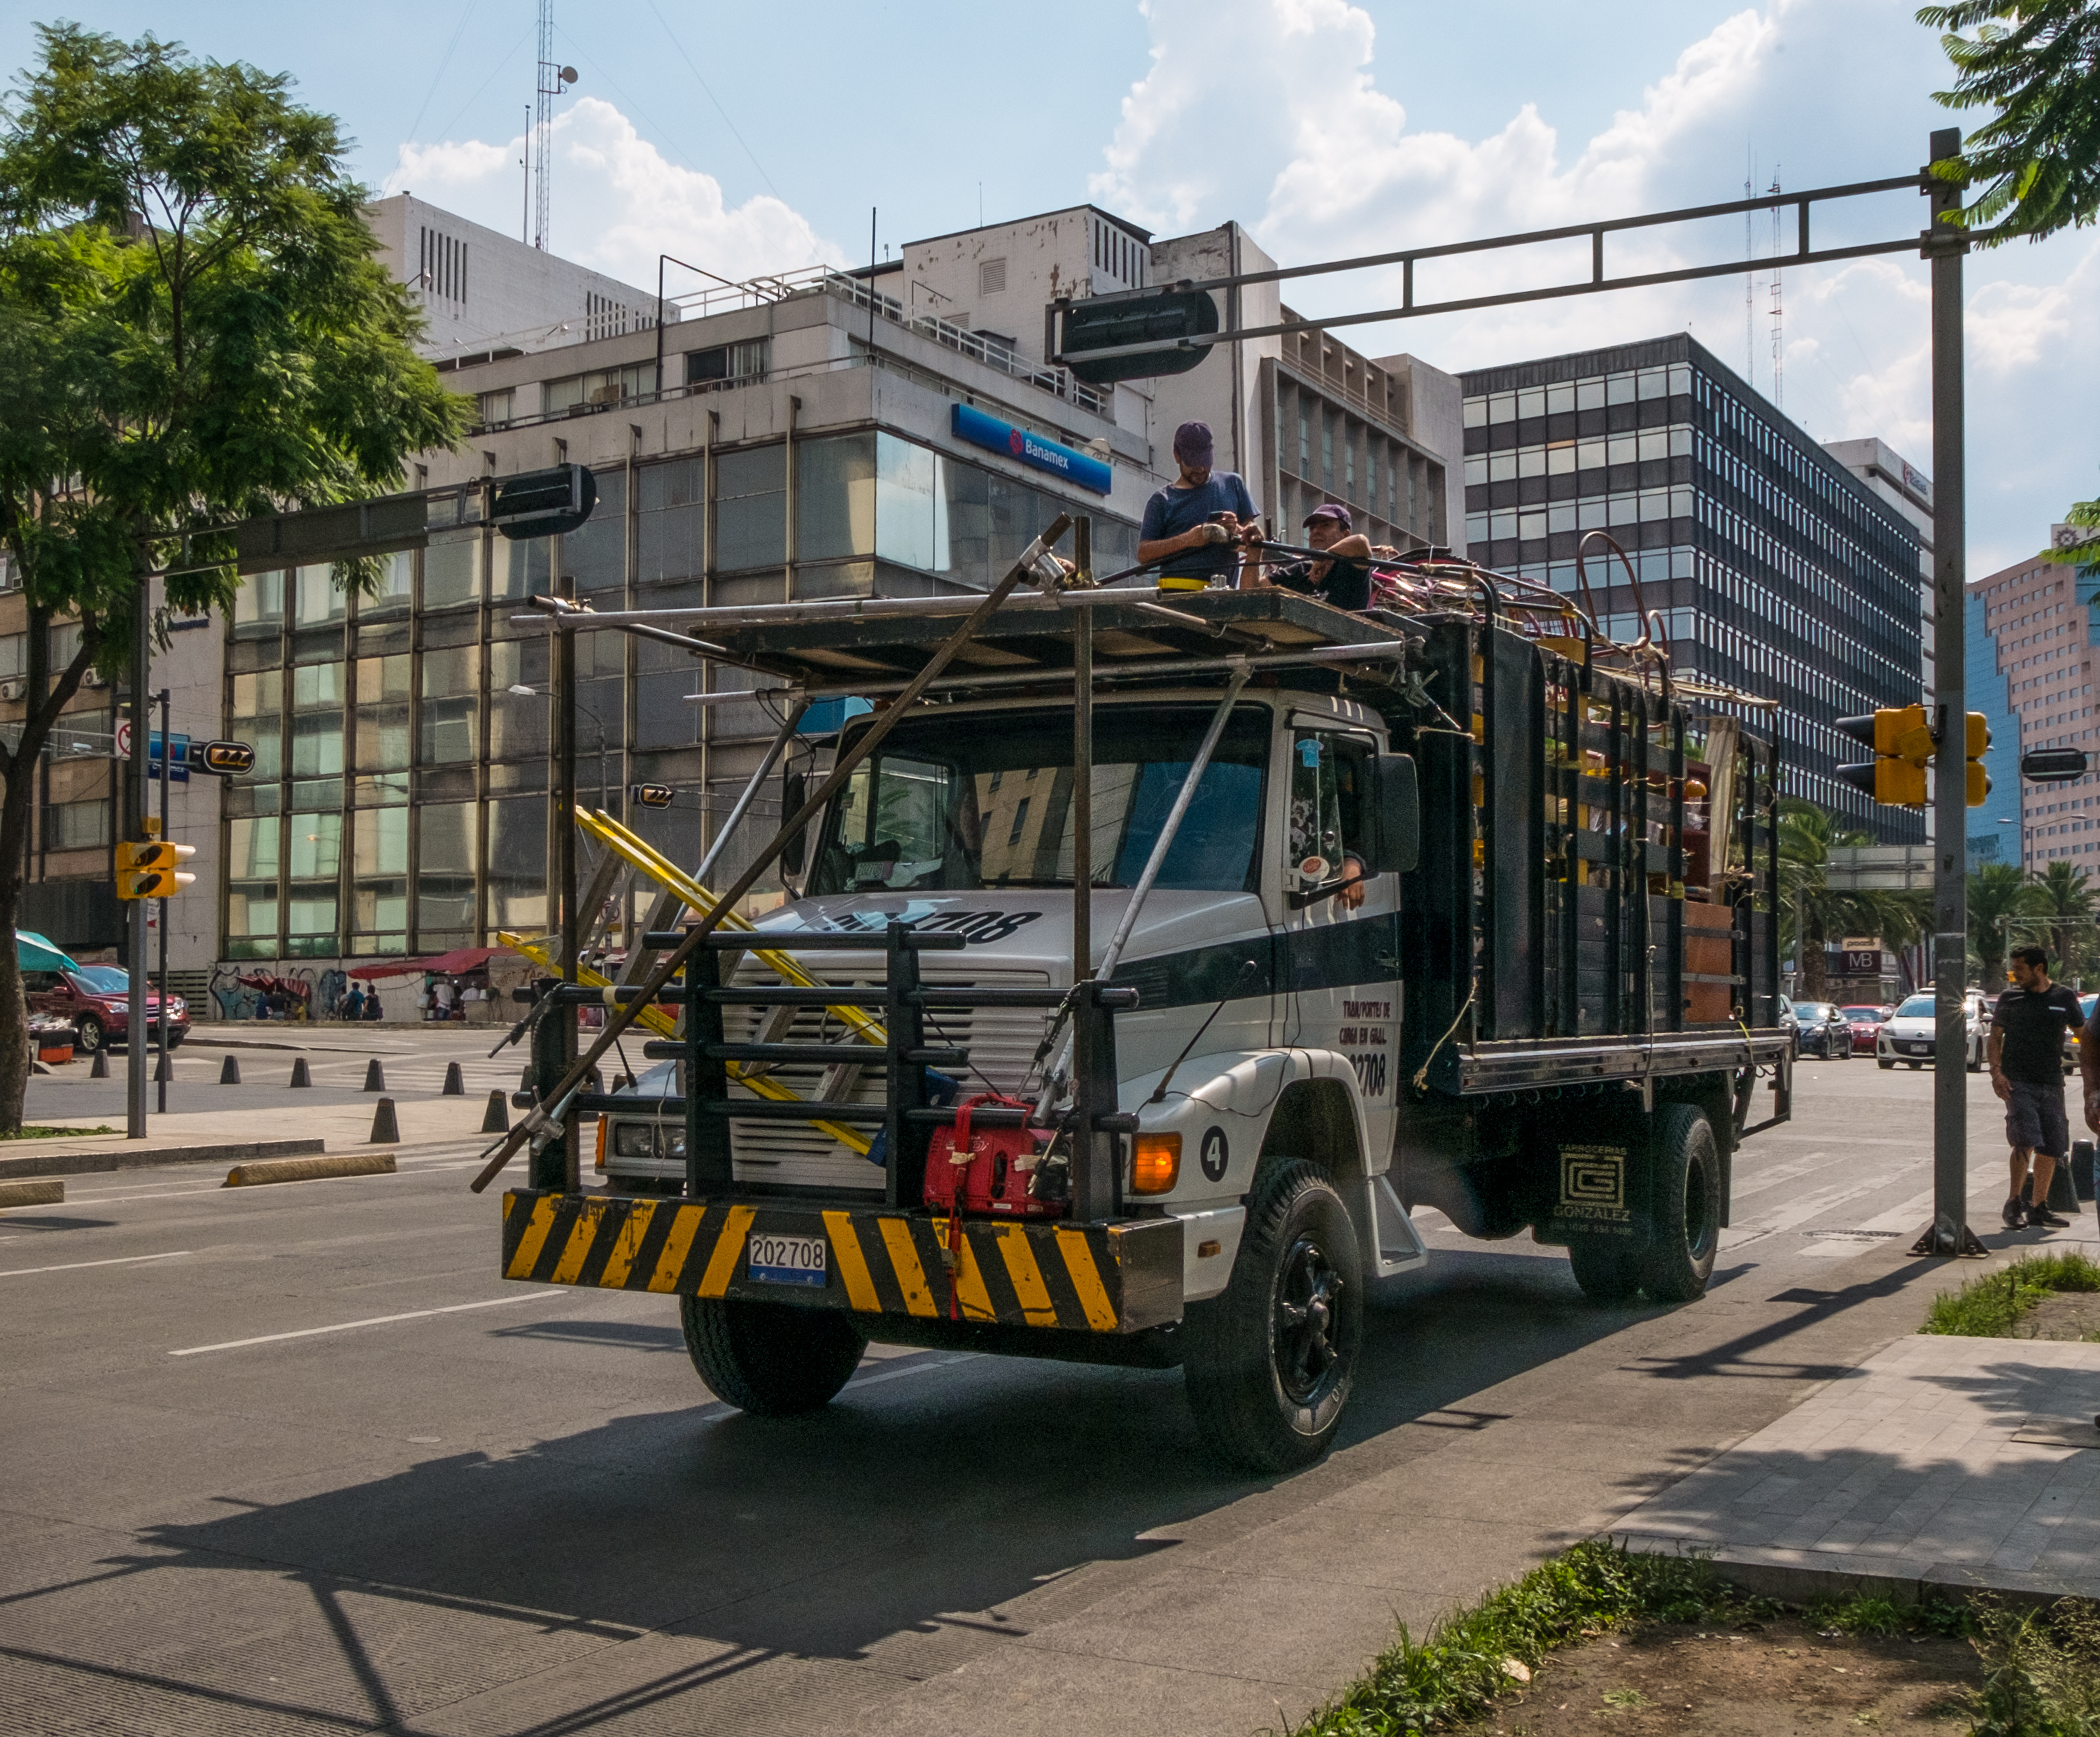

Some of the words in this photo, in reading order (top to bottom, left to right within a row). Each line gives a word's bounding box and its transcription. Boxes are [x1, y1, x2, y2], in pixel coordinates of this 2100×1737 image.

[1026, 438, 1069, 470] Banamex
[1849, 952, 1873, 967] MB
[1343, 1001, 1383, 1020] TRANSPORTES
[1383, 1001, 1390, 1019] DE
[1339, 1027, 1358, 1046] CARGA
[1359, 1027, 1368, 1046] EN
[1207, 1137, 1220, 1171] 4
[1553, 1205, 1630, 1221] GONZALEZ
[752, 1239, 824, 1268] 202708
